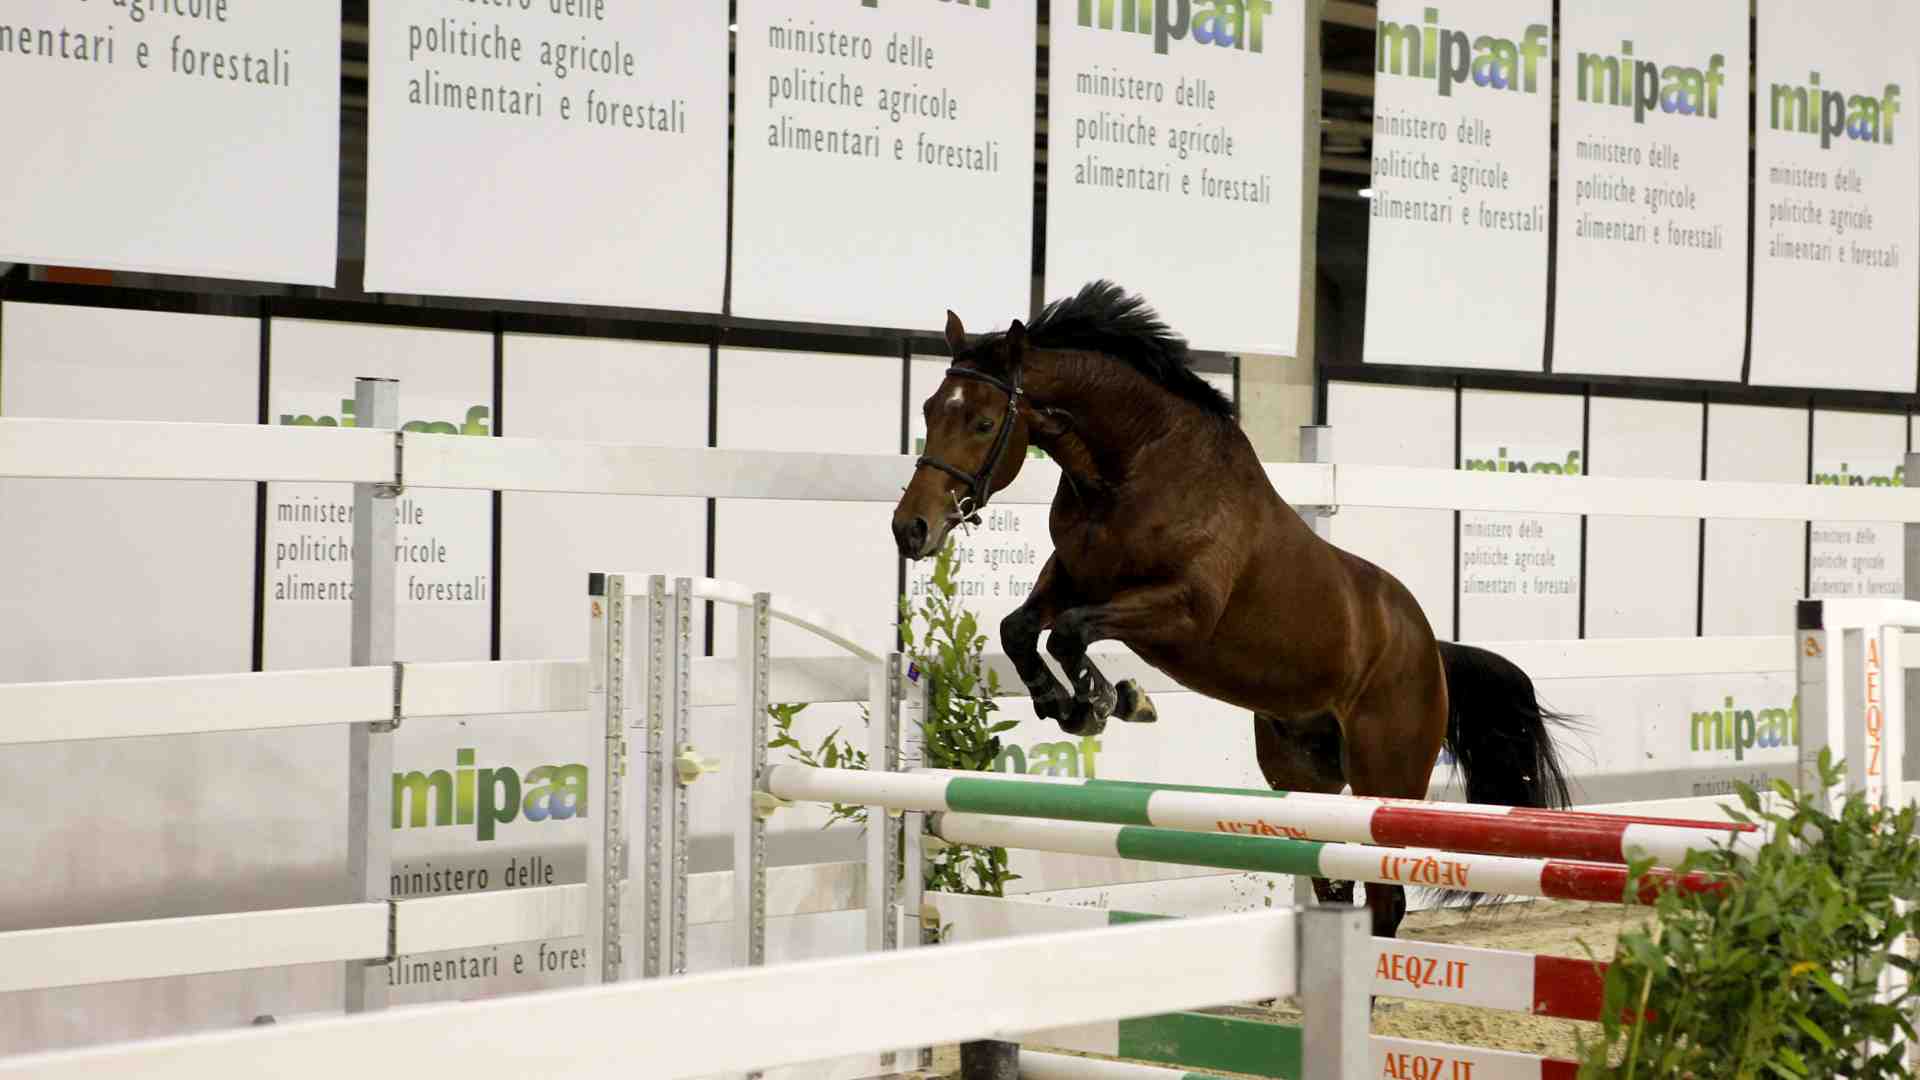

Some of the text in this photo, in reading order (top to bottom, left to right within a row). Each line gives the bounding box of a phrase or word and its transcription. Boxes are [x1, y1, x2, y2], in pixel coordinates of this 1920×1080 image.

[136, 41, 149, 69] e
[171, 34, 289, 87] forestali
[408, 17, 634, 79] politiche agricole
[768, 17, 934, 70] ministero delle
[1377, 7, 1548, 97] mipaaf
[769, 67, 957, 123] politiche agricole
[1076, 65, 1216, 110] ministero delle
[1577, 40, 1725, 124] mipaaf
[408, 69, 685, 134] alimentari e forestali
[1770, 71, 1901, 150] mipaaf
[768, 115, 999, 172] alimentari e forestali
[1076, 111, 1233, 160] politiche agricole
[1457, 116, 1492, 148] delle
[1576, 134, 1680, 171] ministero delle
[1075, 155, 1271, 204] alimentari e forestali
[1452, 160, 1510, 194] agricole
[1576, 173, 1697, 214] politiche agricole
[1769, 160, 1863, 195] ministero delle
[1372, 190, 1544, 233] alimentari e forestali
[1576, 211, 1723, 249] alimentari e forestali
[1769, 197, 1873, 235] politiche agricole
[1770, 233, 1832, 263] alimentari
[1838, 244, 1846, 264] e
[988, 508, 1021, 533] delle
[276, 534, 447, 570] politich ricole
[983, 543, 1036, 571] agricole
[275, 573, 486, 602] aliment forestali
[391, 748, 590, 841] mipaa
[505, 855, 554, 887] delle
[1379, 854, 1471, 888] AEQZ.IT
[514, 954, 524, 974] e
[1375, 952, 1469, 989] AEQZ.IT
[1384, 1051, 1476, 1080] AEQZIT
